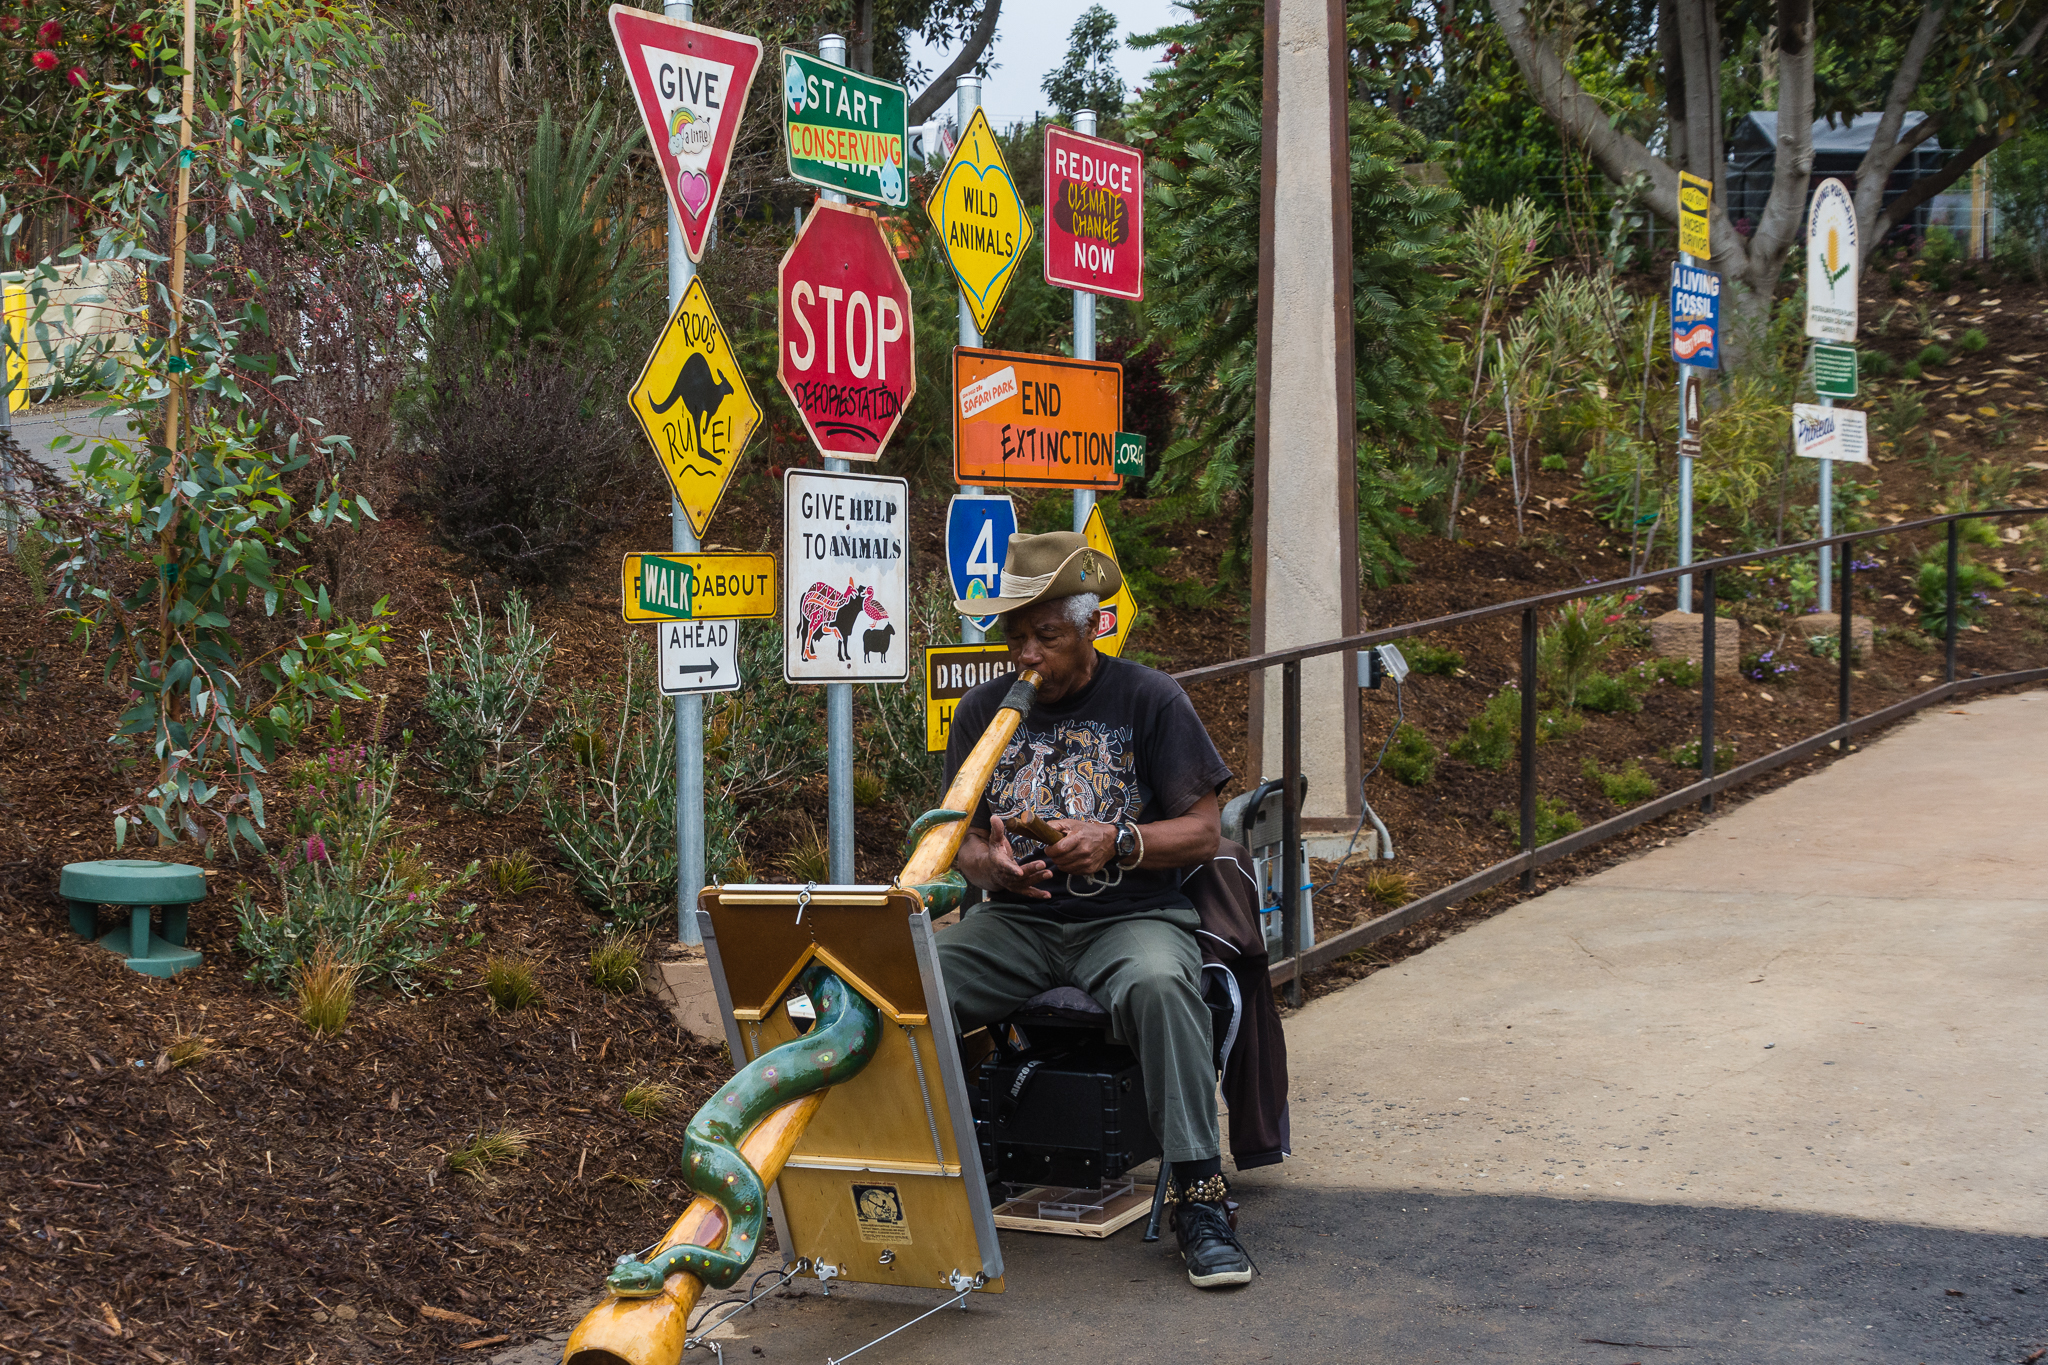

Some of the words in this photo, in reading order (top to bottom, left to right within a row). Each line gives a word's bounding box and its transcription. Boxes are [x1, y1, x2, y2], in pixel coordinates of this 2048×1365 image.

[659, 62, 720, 109] GIVE
[806, 74, 882, 129] START
[685, 131, 690, 144] a
[690, 128, 708, 144] little
[790, 124, 901, 166] CONSERVING
[1055, 148, 1132, 193] REDUCE
[963, 186, 998, 218] WILD
[1068, 181, 1123, 220] CLIMATE
[949, 220, 1013, 258] ANIMALS
[1072, 211, 1120, 244] CHANGE
[1074, 241, 1115, 275] NOW
[1673, 267, 1681, 288] A
[1682, 269, 1720, 297] LIVING
[1675, 291, 1714, 319] FOSSIL
[677, 311, 717, 354] ROOS
[788, 279, 904, 380] STOP
[793, 380, 904, 422] DEFORESTATION
[963, 390, 992, 413] SAFARI
[992, 379, 1015, 399] PARK
[1022, 380, 1061, 417] END
[1001, 423, 1112, 466] EXTINCTION
[1117, 442, 1144, 467] .ORG
[802, 492, 845, 521] GIVE
[849, 497, 897, 524] HELP
[802, 532, 826, 560] TO
[829, 535, 902, 560] ANIMALS
[966, 519, 999, 589] 4
[645, 563, 690, 612] WALK
[669, 624, 728, 649] AHEAD
[936, 661, 1016, 689] DROUG
